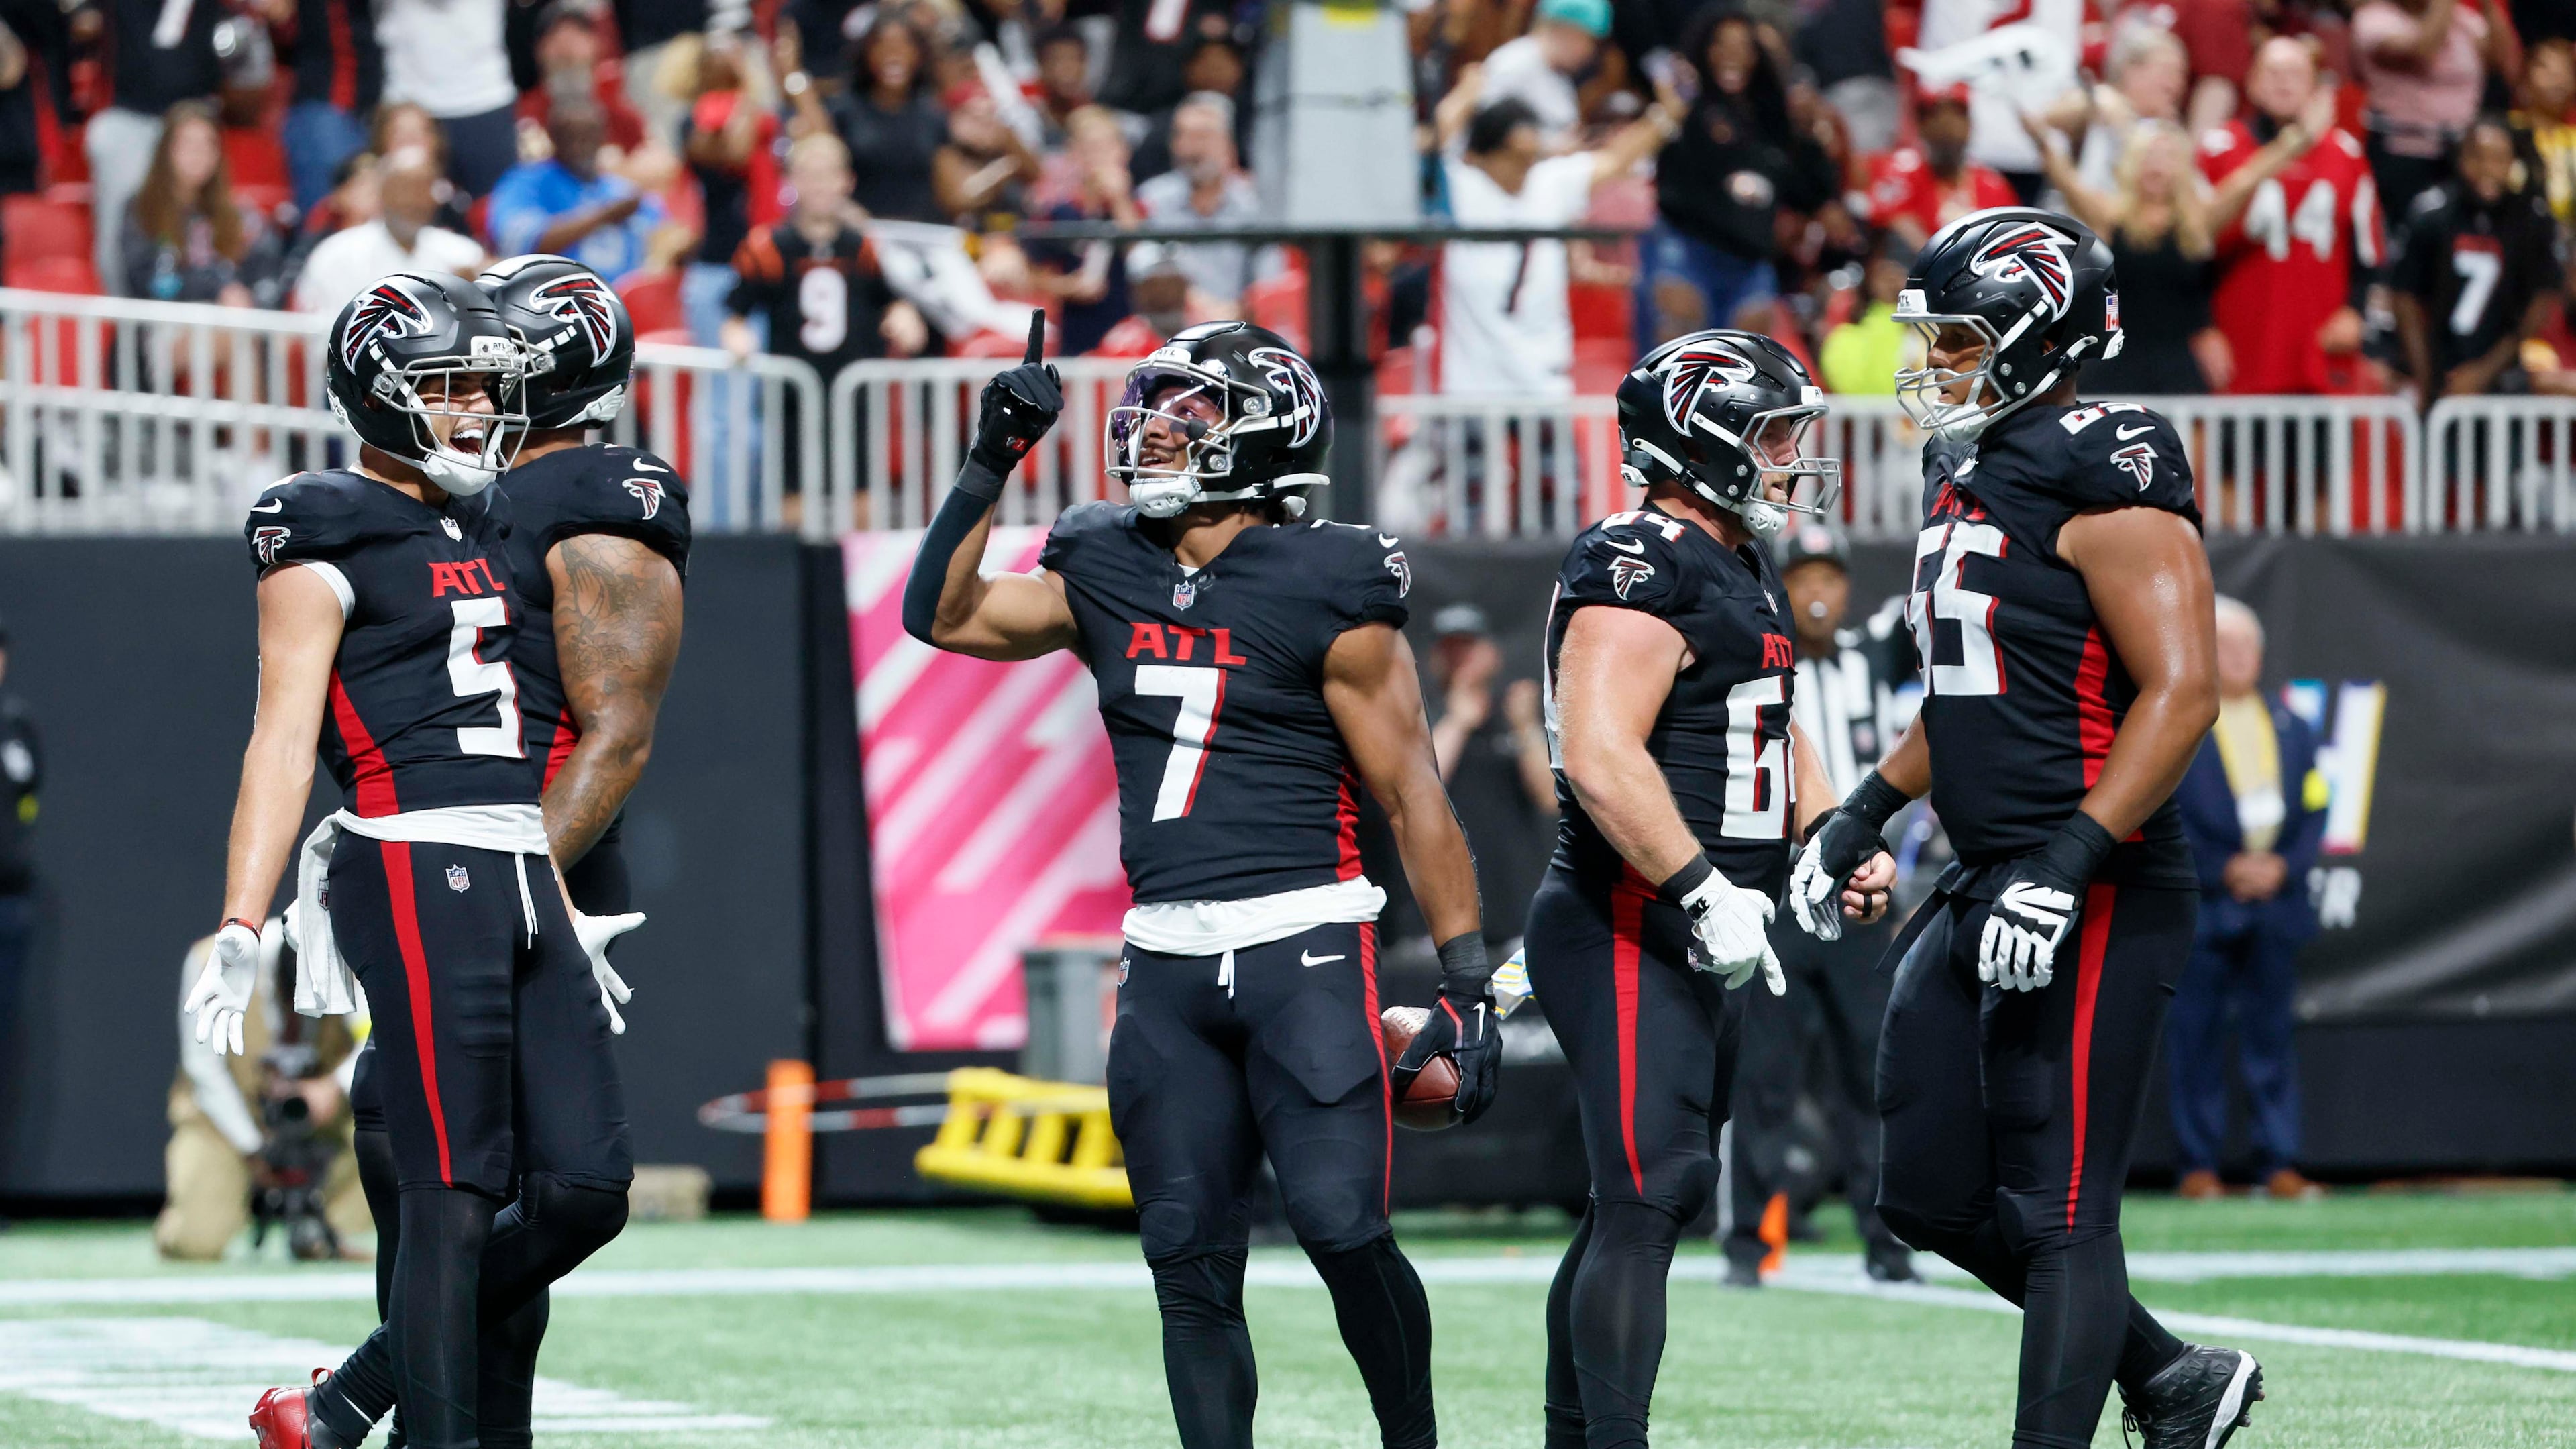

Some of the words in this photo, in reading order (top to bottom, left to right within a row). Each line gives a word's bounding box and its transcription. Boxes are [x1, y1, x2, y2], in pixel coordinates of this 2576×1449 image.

[2243, 177, 2337, 262] 44
[799, 266, 847, 353] 9
[2452, 249, 2502, 335] 7
[428, 557, 506, 598] ATL
[446, 596, 529, 759] 5
[1125, 621, 1248, 667] ATL
[1134, 664, 1228, 823] 7
[1720, 674, 1797, 839] 6
